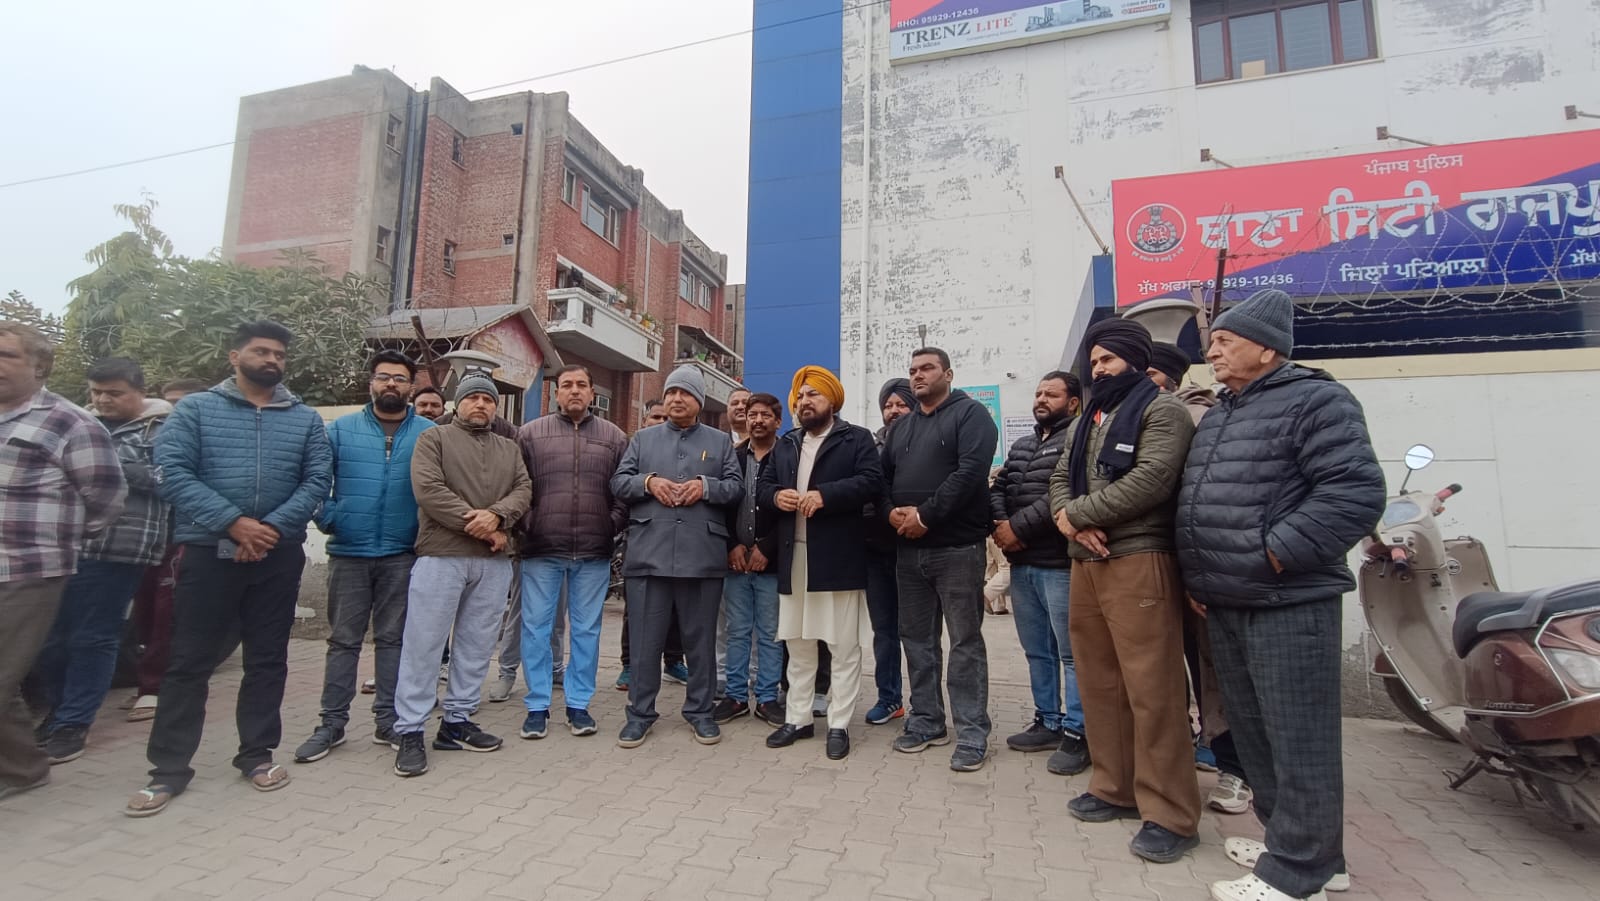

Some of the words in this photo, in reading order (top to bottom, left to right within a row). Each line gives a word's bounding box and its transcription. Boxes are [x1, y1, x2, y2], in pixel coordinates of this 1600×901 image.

[902, 22, 971, 45] TRENZ
[976, 17, 1013, 33] LITE
[1363, 159, 1410, 175] ਪੰਜਾਬ
[1413, 153, 1464, 173] ਪੁਲਿਸ
[1196, 208, 1303, 249] ਥਾਣਾ
[1321, 180, 1440, 243] ਸਿਟੀ
[1393, 258, 1487, 278] ਪਟਿਆਲਾ
[1207, 274, 1294, 289] 9929-12436
